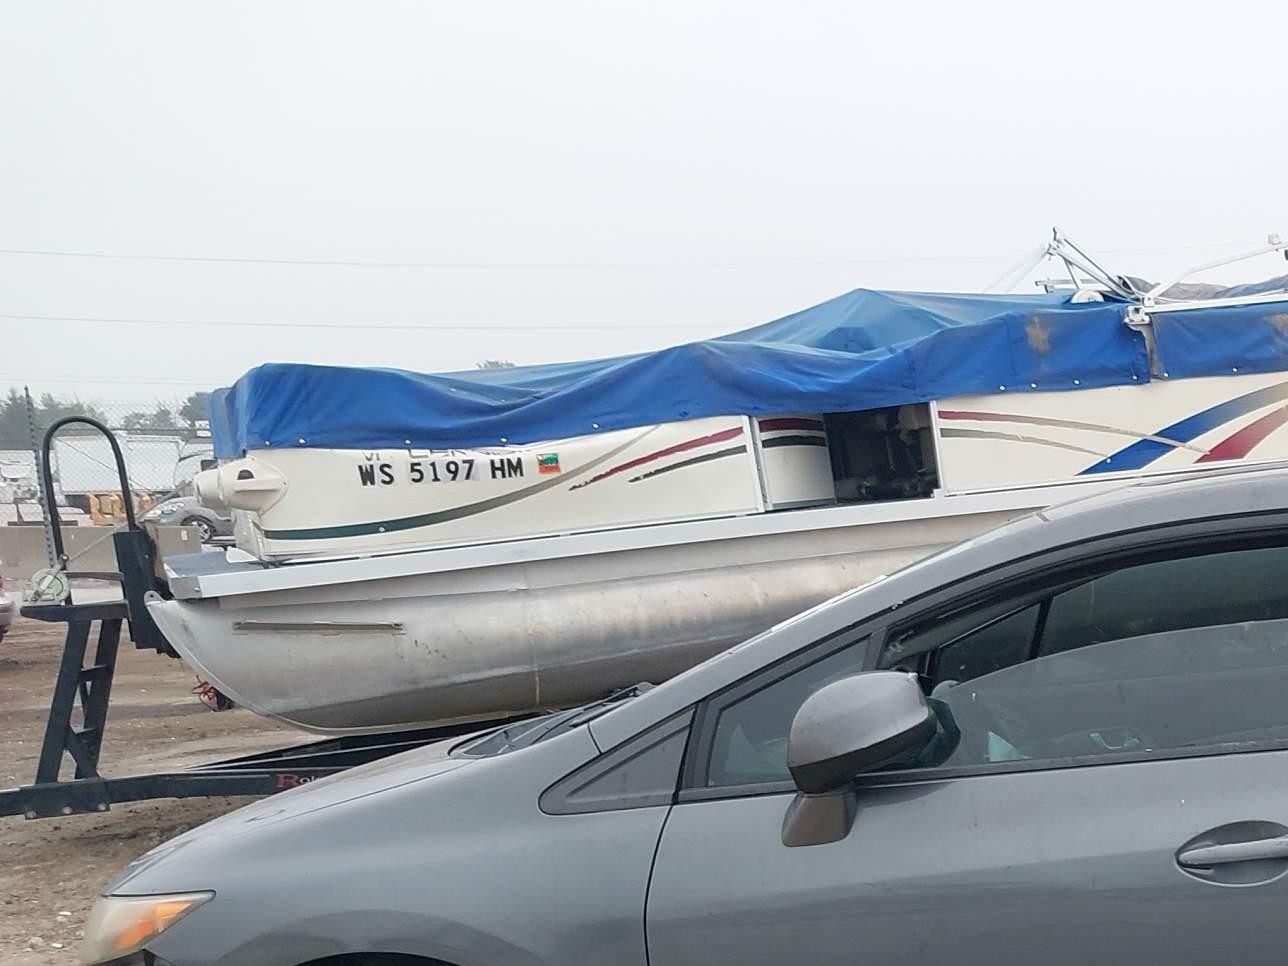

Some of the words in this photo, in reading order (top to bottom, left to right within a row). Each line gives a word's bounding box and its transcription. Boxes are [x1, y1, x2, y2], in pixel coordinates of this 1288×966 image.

[358, 463, 395, 486] WS
[410, 459, 474, 483] 5197
[490, 457, 524, 479] HM
